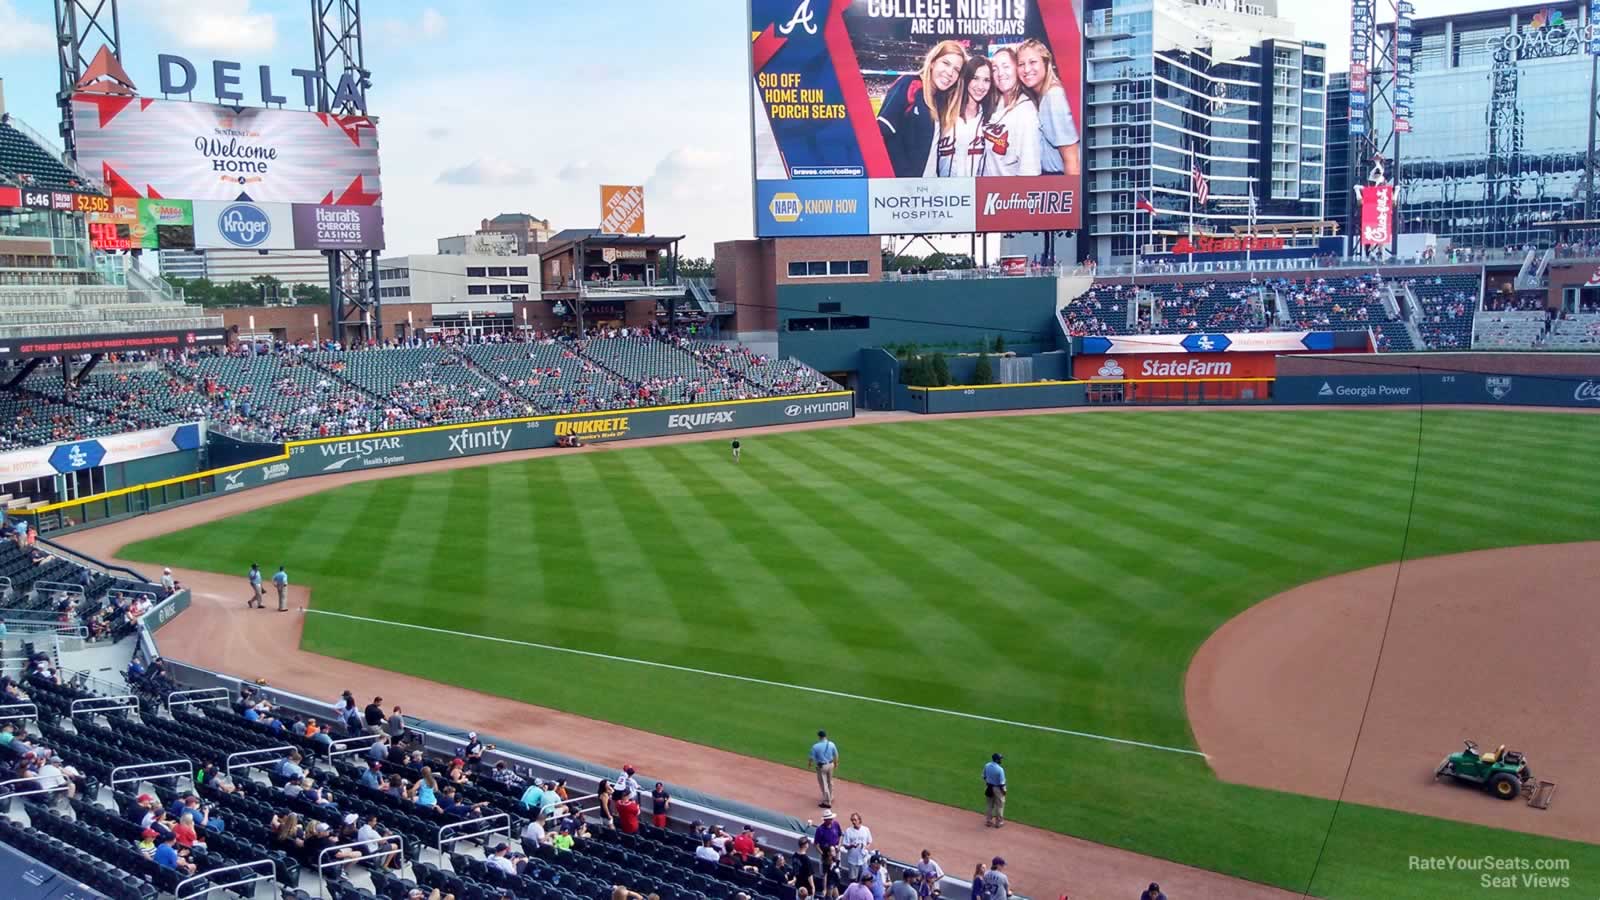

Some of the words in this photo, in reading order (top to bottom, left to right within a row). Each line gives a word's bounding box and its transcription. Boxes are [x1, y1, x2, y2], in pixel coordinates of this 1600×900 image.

[867, 0, 951, 17] COLLEGE
[956, 0, 1025, 19] NIGHTS
[911, 19, 934, 34] ARE
[938, 19, 954, 34] ON
[957, 19, 1025, 35] THURSDAYS
[157, 53, 367, 111] DELTA
[759, 72, 778, 88] $10
[781, 73, 801, 87] OFF
[765, 89, 797, 103] HOME
[801, 89, 824, 103] RUN
[772, 105, 809, 119] PORCH
[812, 105, 846, 119] SEATS
[195, 136, 278, 160] Welcome
[793, 168, 861, 177] braves.com/college
[26, 193, 49, 206] 6:46
[78, 195, 109, 212] $2,505
[607, 191, 623, 210] THE
[775, 200, 798, 214] NAPA
[804, 200, 833, 214] KNOW
[835, 200, 857, 214] HOW
[875, 195, 971, 208] NORTHSIDE
[983, 192, 1040, 215] Kauffman
[1027, 191, 1074, 214] TIRE
[315, 208, 360, 222] Harrah's
[602, 186, 643, 232] HOME
[892, 210, 954, 219] HOSPITAL
[224, 210, 267, 241] Kroger
[620, 205, 644, 233] DEPOT
[91, 224, 117, 240] 40
[317, 223, 361, 231] CHEROKEE
[318, 231, 361, 239] CASINOS
[93, 240, 131, 248] MILLION
[1336, 385, 1376, 397] Georgia
[1379, 385, 1411, 395] Power
[804, 401, 849, 413] HYUNDAI
[555, 417, 629, 435] QUIKRETE
[668, 411, 733, 429] EQUIFAX
[320, 437, 401, 456] WELLSTAR
[449, 429, 512, 454] xfinity
[290, 446, 305, 455] 375
[364, 457, 382, 466] Health
[384, 456, 404, 464] System
